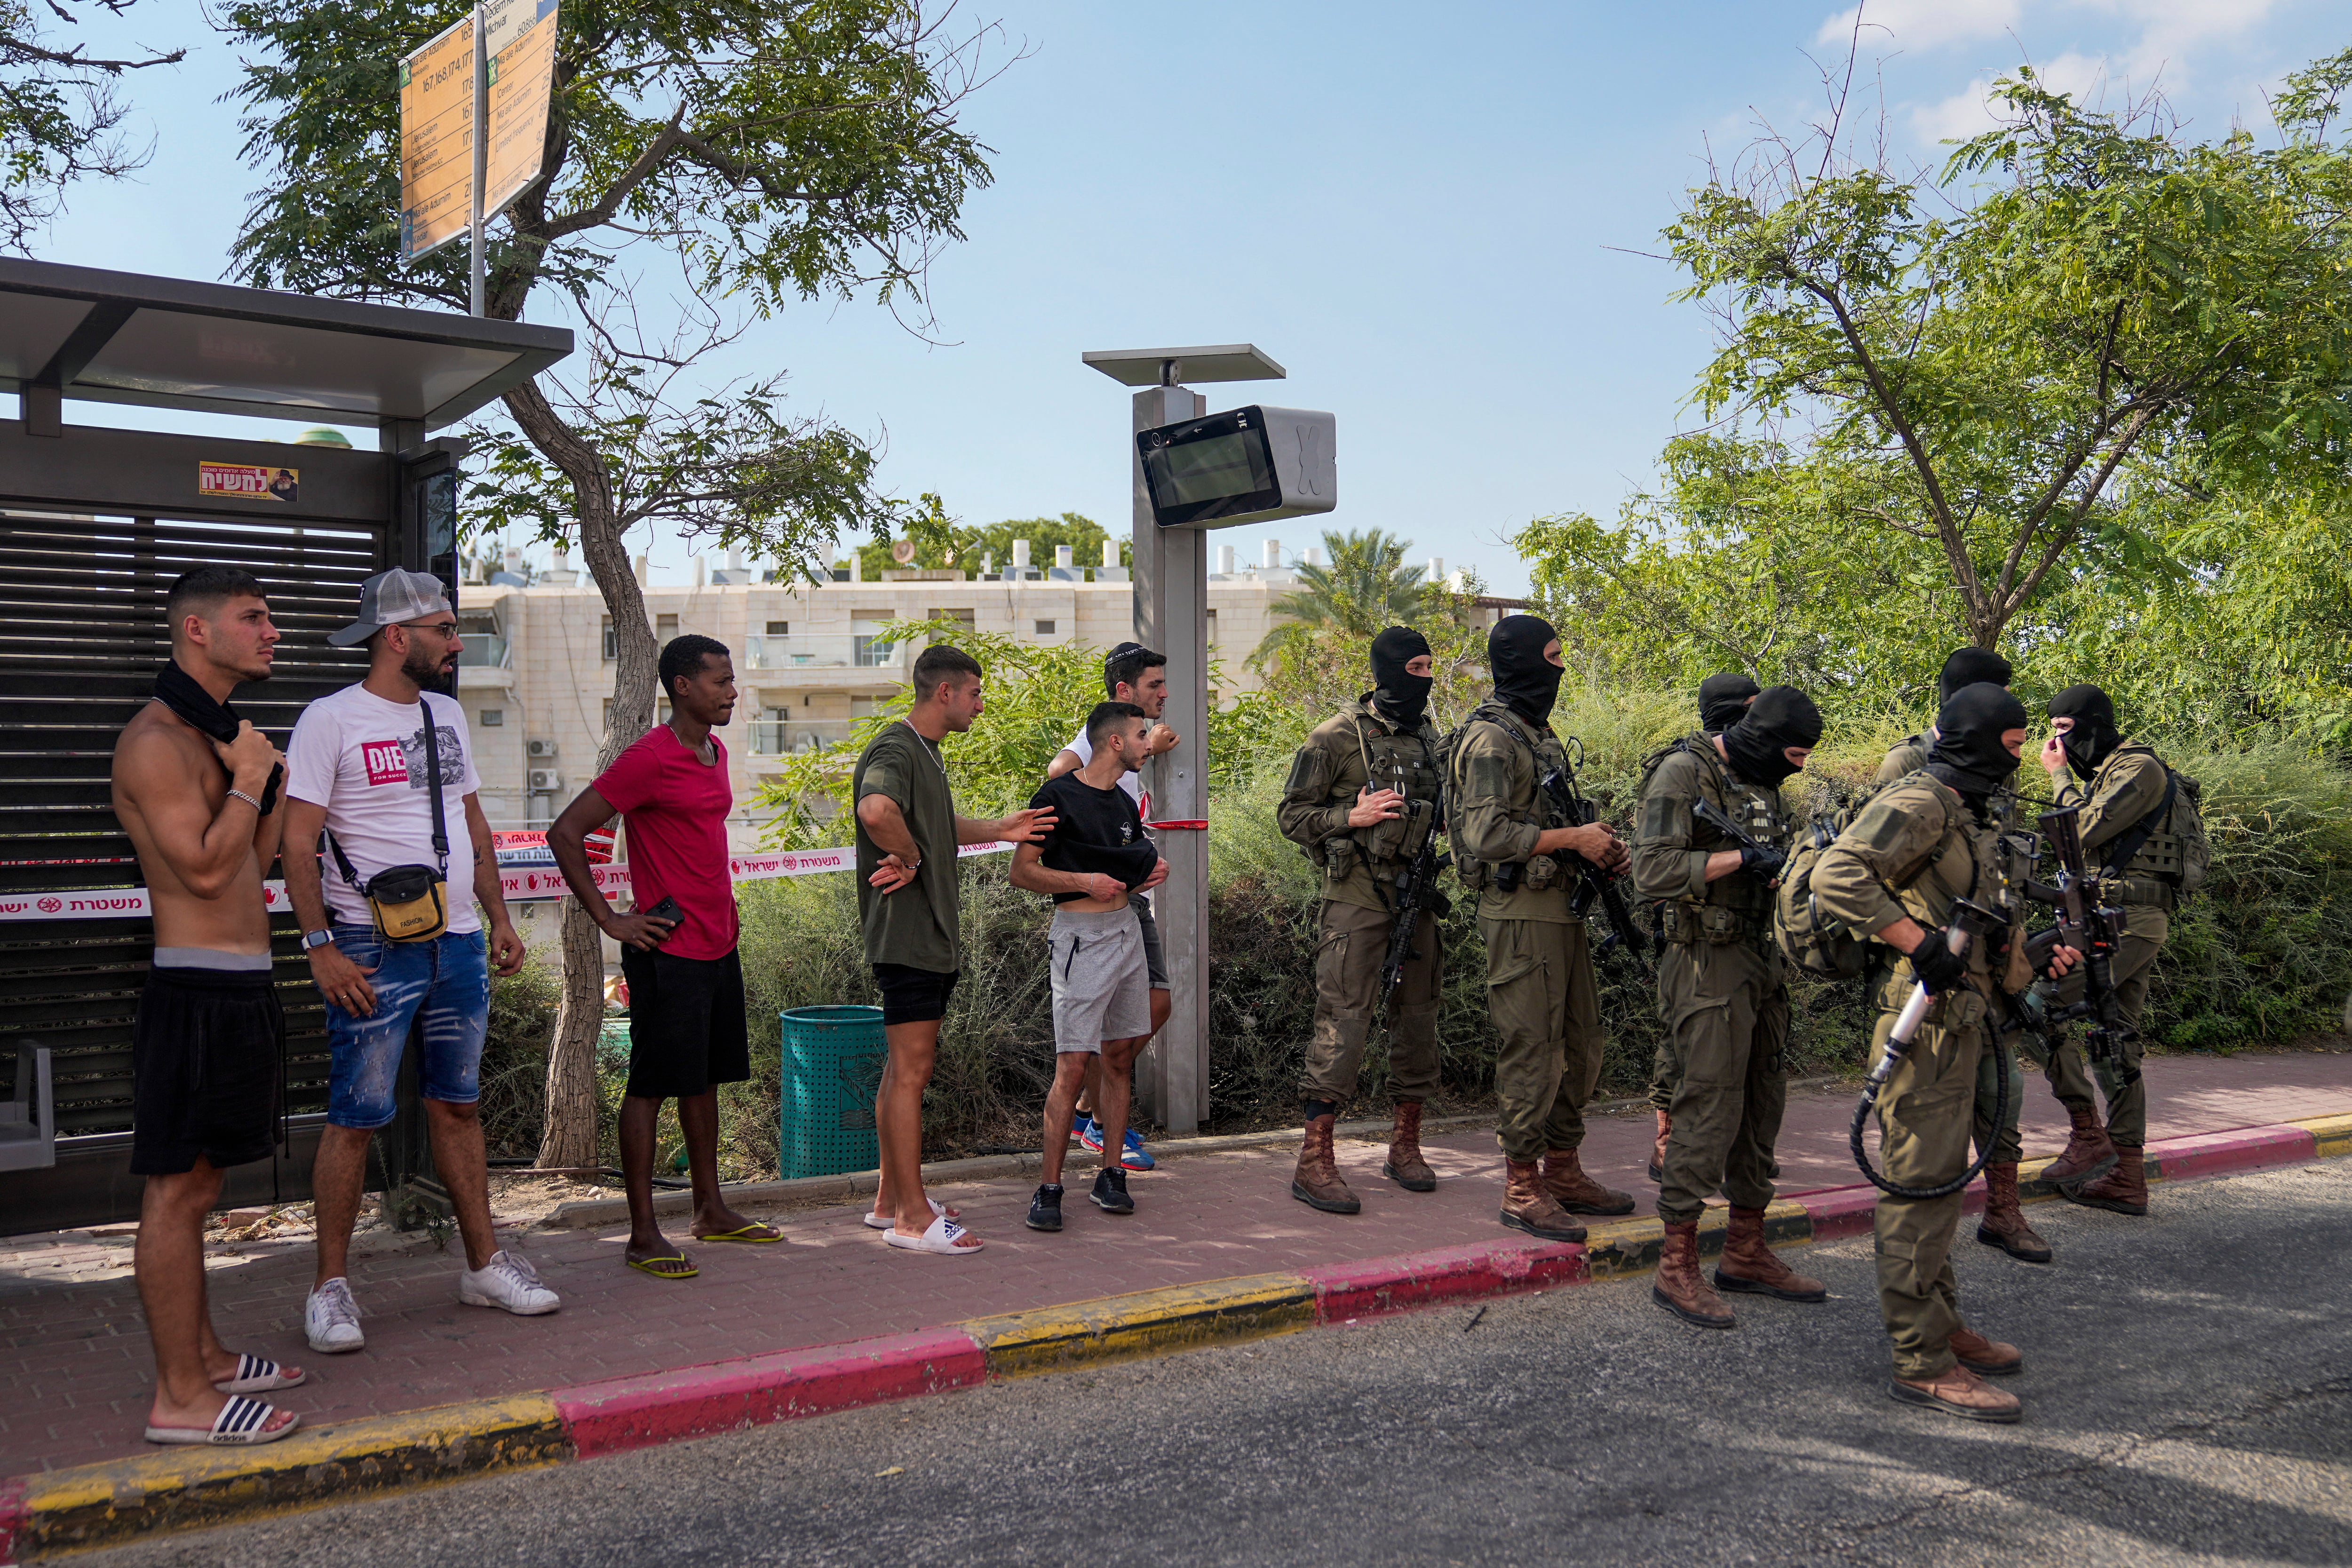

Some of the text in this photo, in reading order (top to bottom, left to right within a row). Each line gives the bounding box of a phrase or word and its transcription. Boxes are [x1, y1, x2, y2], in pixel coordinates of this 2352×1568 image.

[485, 0, 506, 22] Kedem
[485, 14, 507, 38] Michvar
[517, 13, 536, 36] 60866
[411, 24, 473, 67] Ma'ale Adumim 165
[498, 16, 556, 67] Ma'ale Adumim 22
[544, 44, 553, 63] 23
[462, 76, 473, 94] 178
[498, 81, 513, 99] Center
[498, 71, 550, 120] Ma'ale Adumim 25
[539, 100, 547, 118] 89
[413, 102, 473, 144] Jerusalem 167
[496, 115, 533, 152] Limited frequency
[536, 127, 544, 145] 92
[412, 128, 473, 169] Jerusalem 177
[506, 170, 523, 188] Adumim
[413, 205, 429, 220] Ma'ale
[429, 192, 451, 210] Adumim
[413, 230, 428, 245] Kedar
[202, 468, 267, 492] למשיח
[368, 746, 406, 774] DIE
[744, 856, 840, 872] משטרת ישראל
[69, 897, 142, 911] משטרת
[400, 917, 422, 928] FASHION
